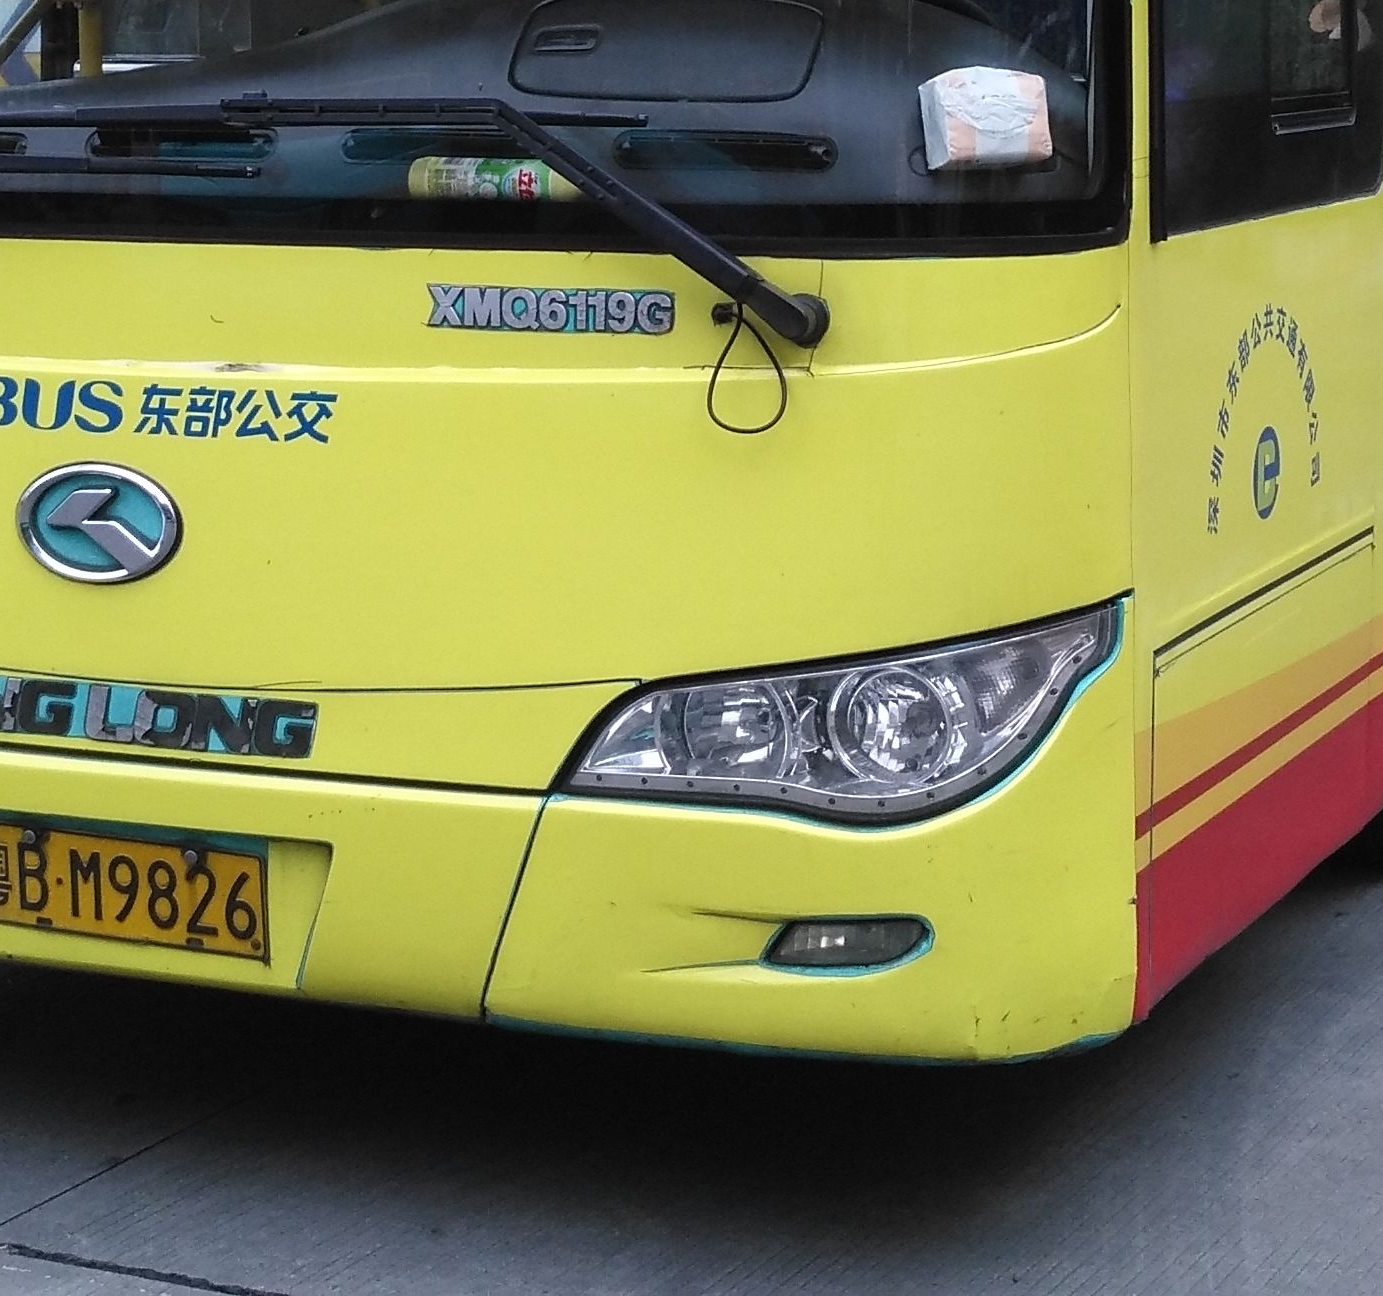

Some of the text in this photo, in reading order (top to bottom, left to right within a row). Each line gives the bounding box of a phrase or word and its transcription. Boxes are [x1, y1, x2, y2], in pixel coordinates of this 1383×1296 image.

[426, 284, 675, 336] XMQ6119G
[133, 383, 339, 444] 东部公交
